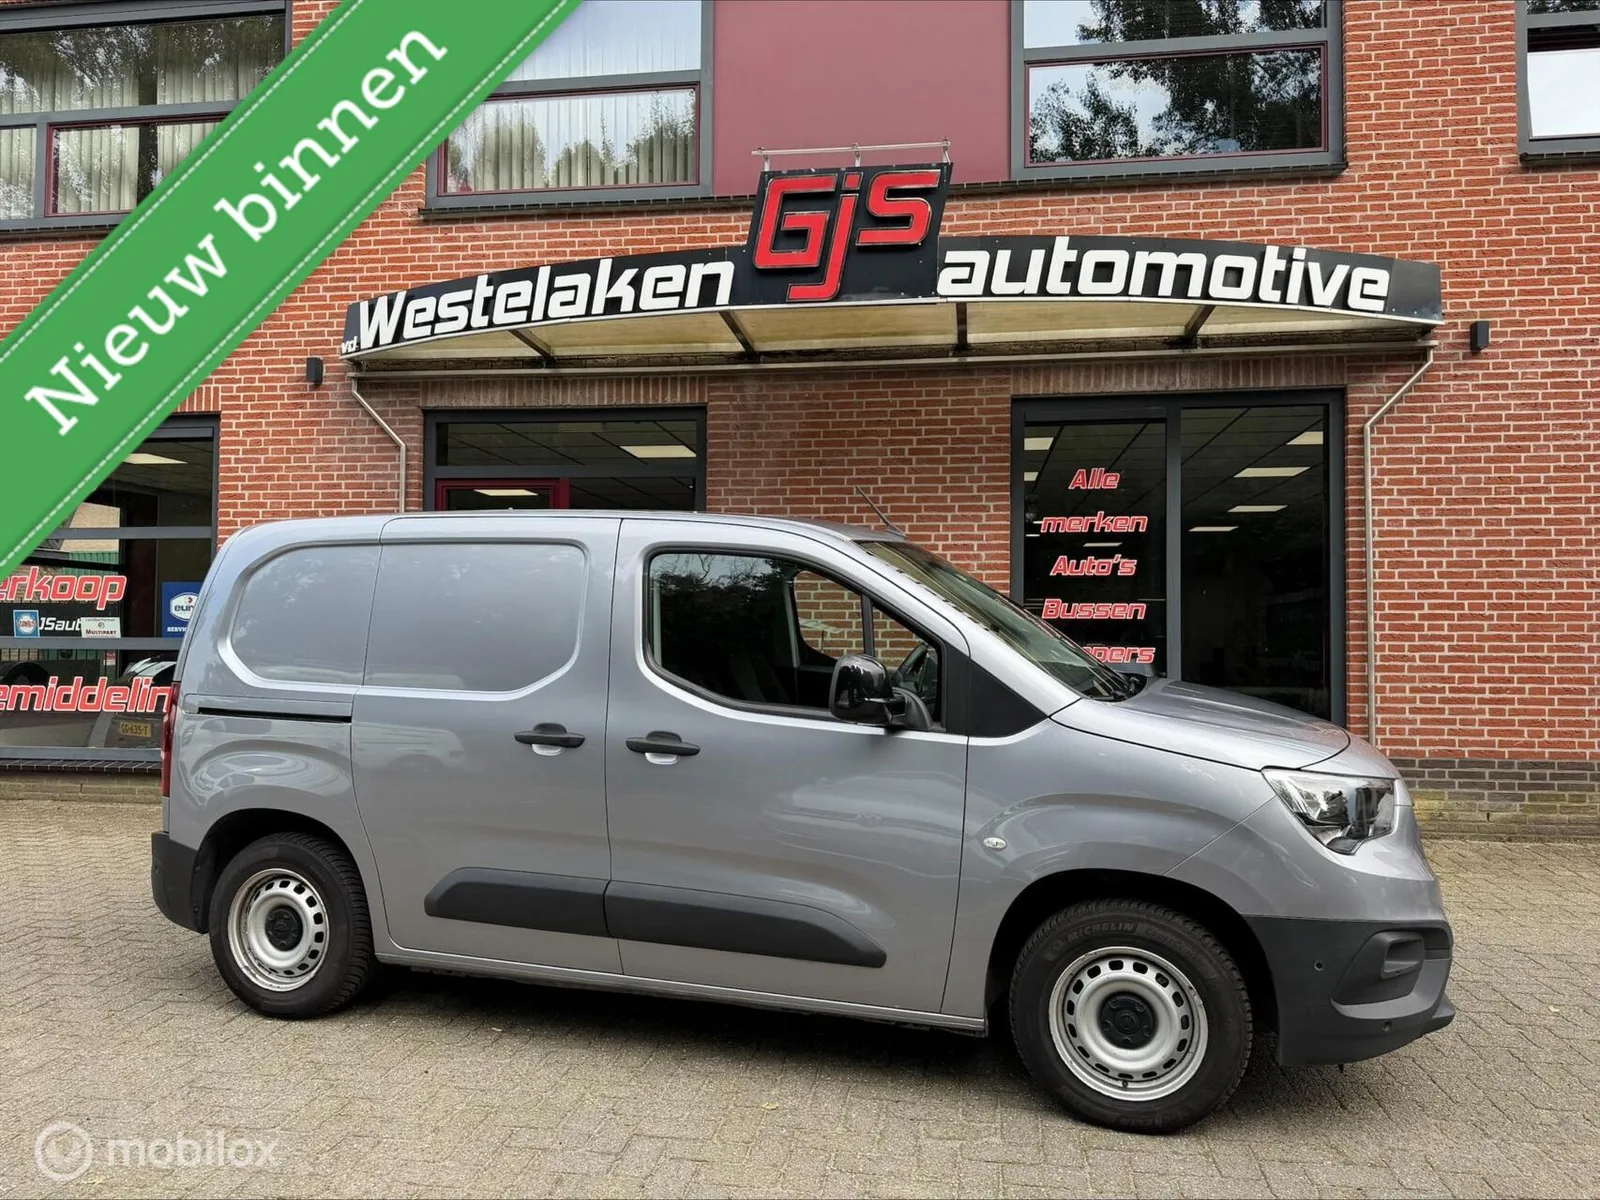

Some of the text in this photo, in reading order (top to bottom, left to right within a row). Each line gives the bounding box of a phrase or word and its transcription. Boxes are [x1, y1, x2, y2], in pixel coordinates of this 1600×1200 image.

[360, 258, 734, 349] Westelaken
[937, 236, 1390, 311] automotive
[1068, 468, 1121, 489] Alle
[1040, 511, 1148, 532] merken
[1049, 554, 1137, 576] Auto's
[0, 566, 127, 610] rkoop
[1042, 598, 1146, 619] Bussen
[1082, 646, 1155, 664] pers
